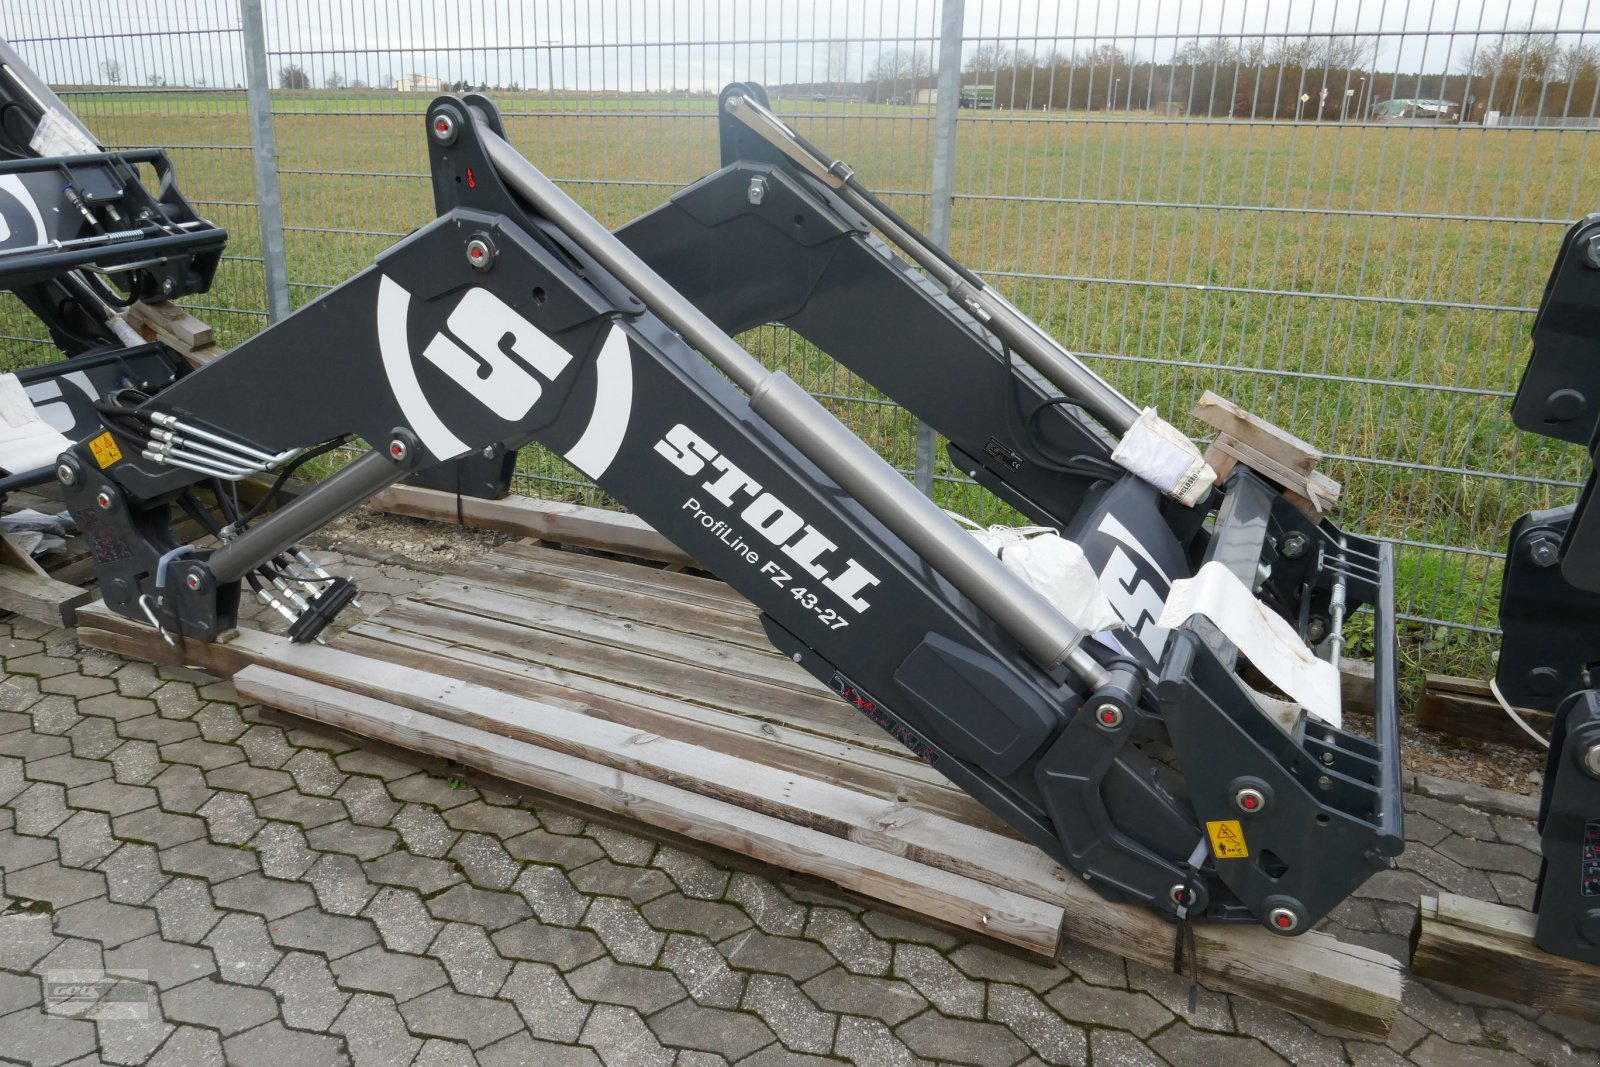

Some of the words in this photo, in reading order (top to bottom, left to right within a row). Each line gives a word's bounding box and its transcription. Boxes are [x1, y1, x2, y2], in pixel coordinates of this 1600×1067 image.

[422, 286, 574, 421] S
[652, 423, 882, 614] STOLL
[1175, 473, 1198, 500] ENCLOSED
[681, 497, 760, 565] ProfiLine
[760, 560, 793, 589] FZ
[790, 586, 850, 631] 43-27
